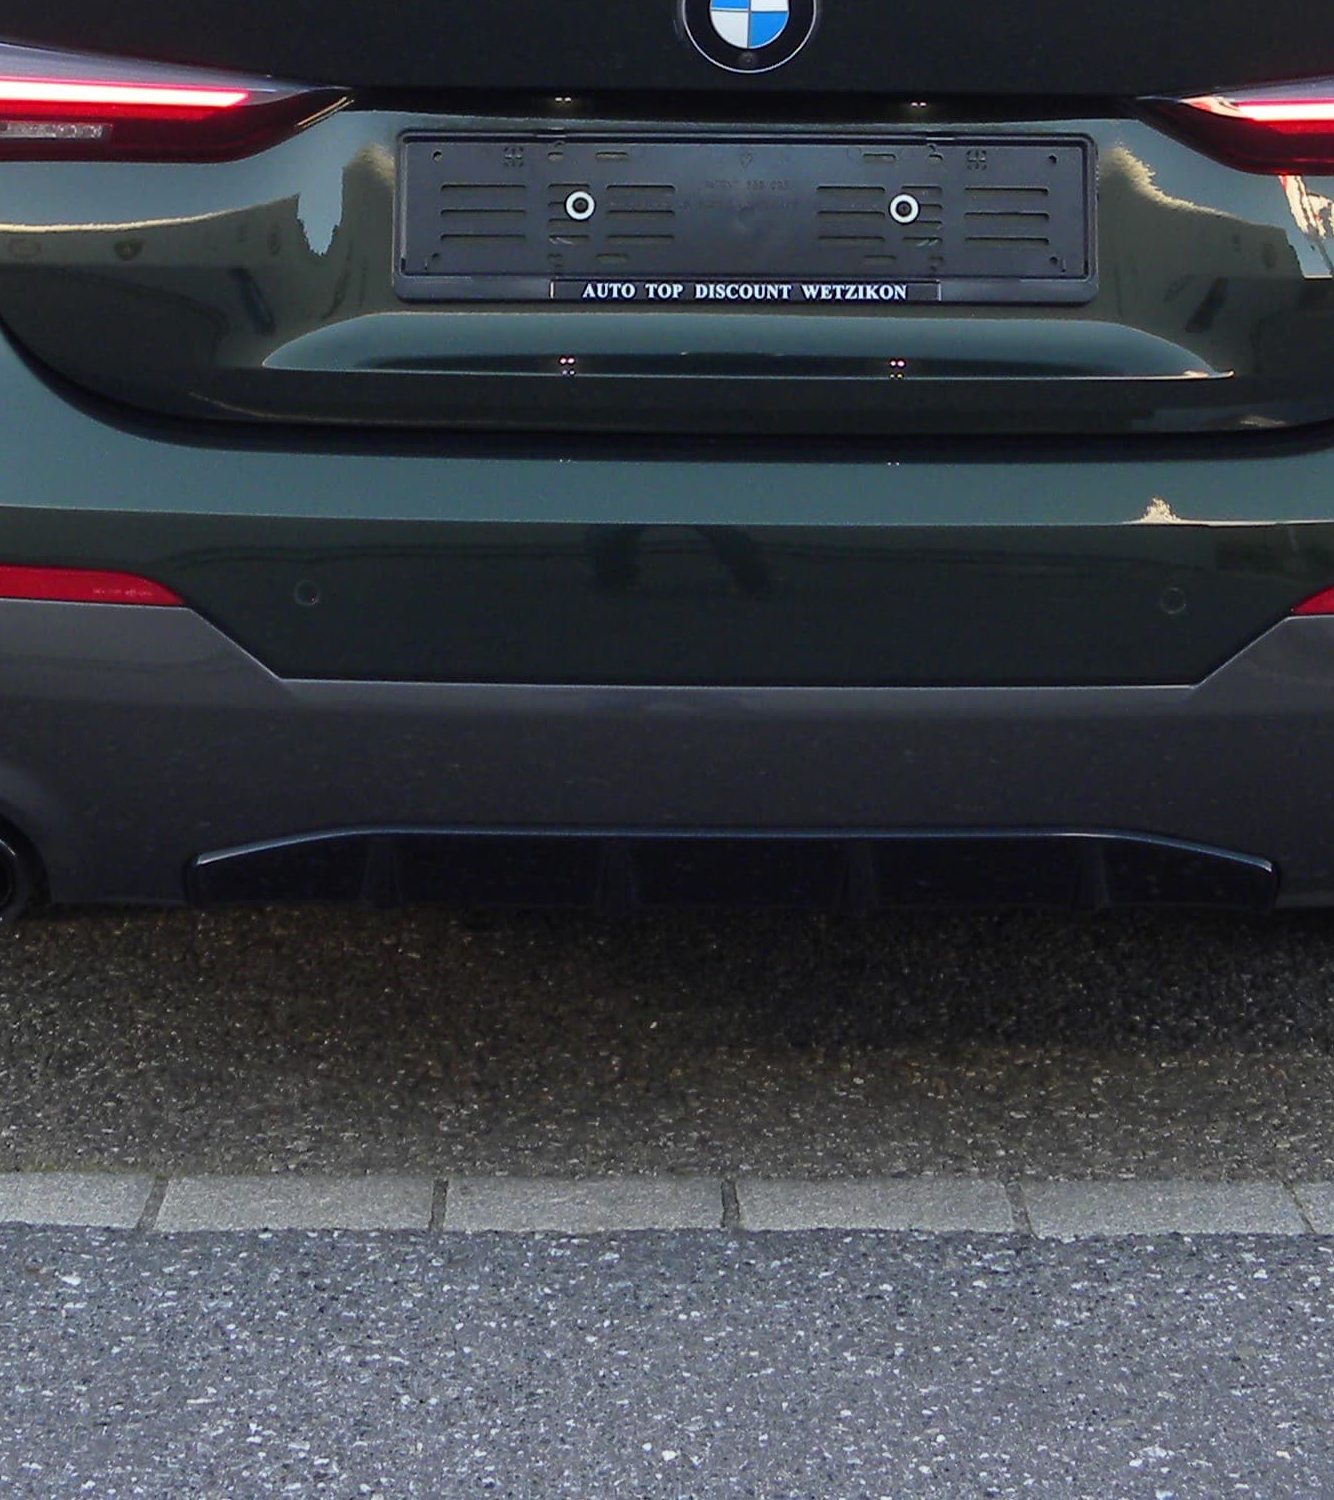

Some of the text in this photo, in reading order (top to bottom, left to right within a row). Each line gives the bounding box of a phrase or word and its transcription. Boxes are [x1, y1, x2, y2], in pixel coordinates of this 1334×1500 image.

[582, 283, 907, 300] AUTO TOP DISCOUNT WETZIKON
